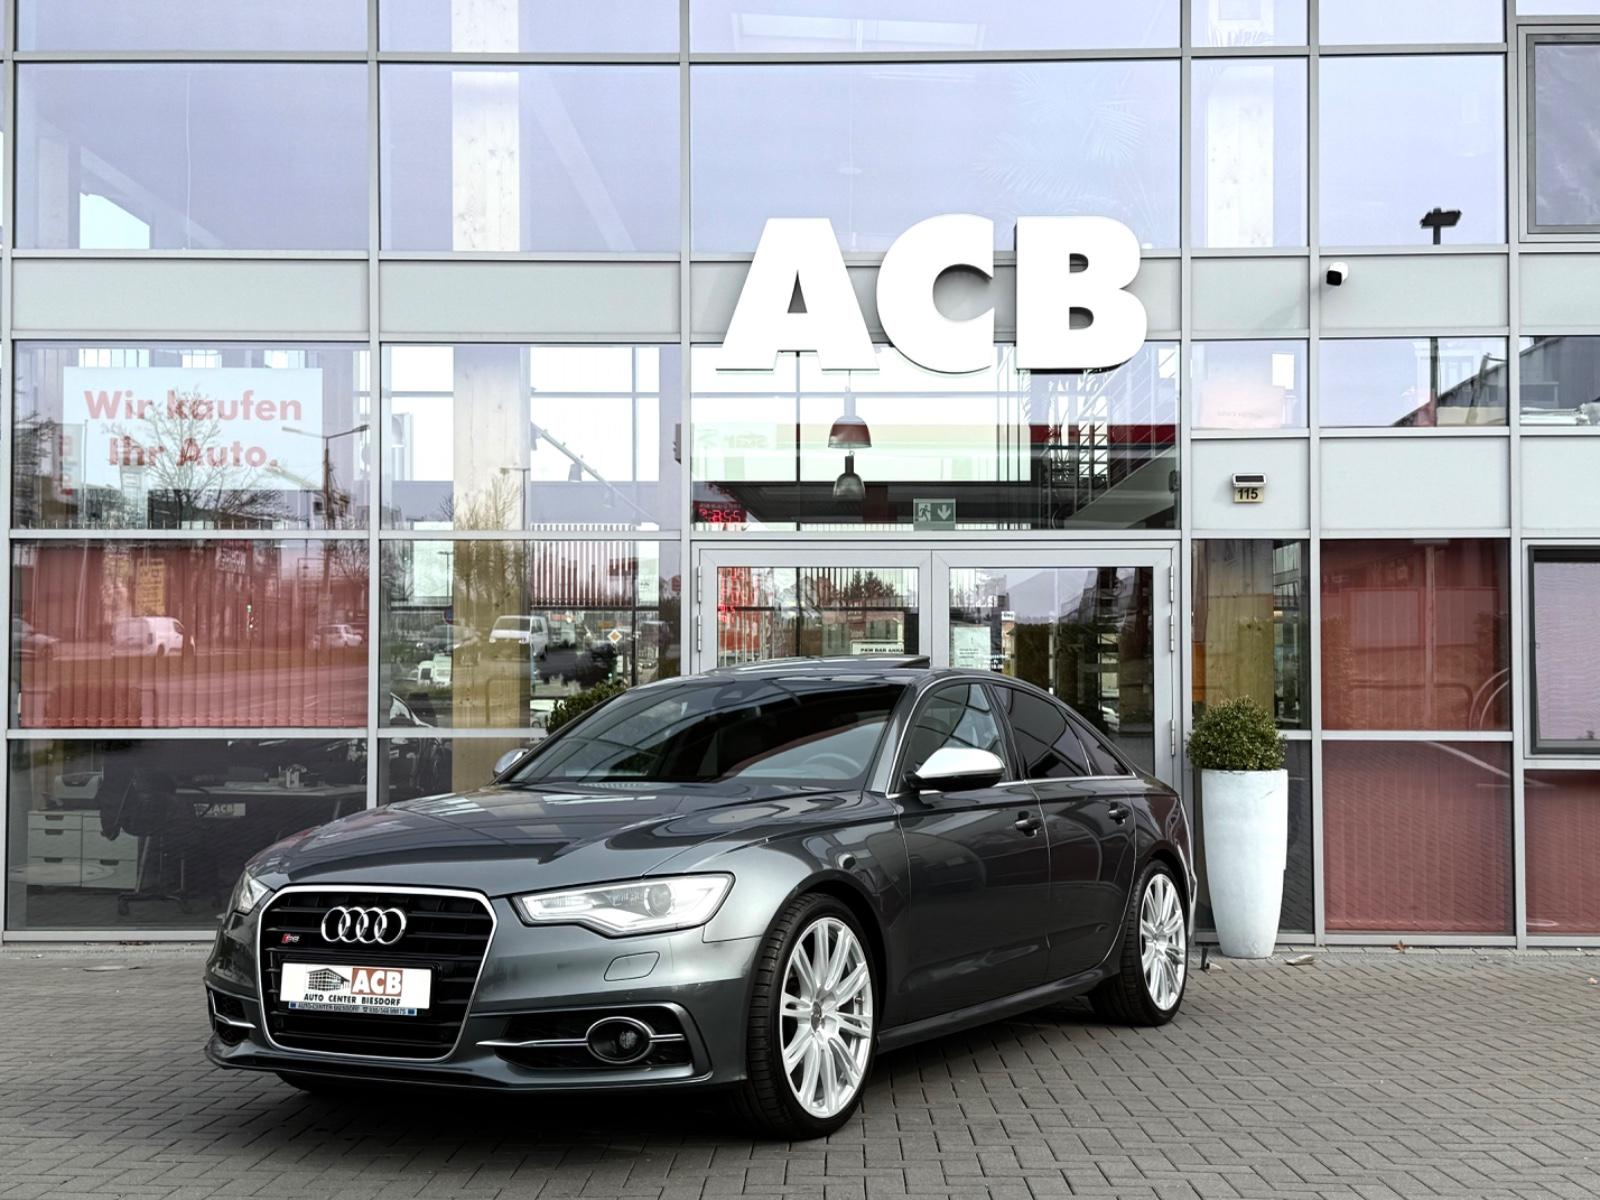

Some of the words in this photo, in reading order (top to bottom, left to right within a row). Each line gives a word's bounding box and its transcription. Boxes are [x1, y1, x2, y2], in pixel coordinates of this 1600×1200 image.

[716, 213, 1147, 374] ACB
[84, 390, 151, 420] Wir
[167, 390, 302, 421] kaufen
[109, 436, 163, 466] Ihr
[176, 437, 278, 467] Auto.
[1237, 487, 1259, 500] 115
[351, 969, 402, 995] ACB
[304, 993, 325, 1003] AUTO
[328, 994, 357, 1004] CENTER
[361, 996, 402, 1006] BIESDORF
